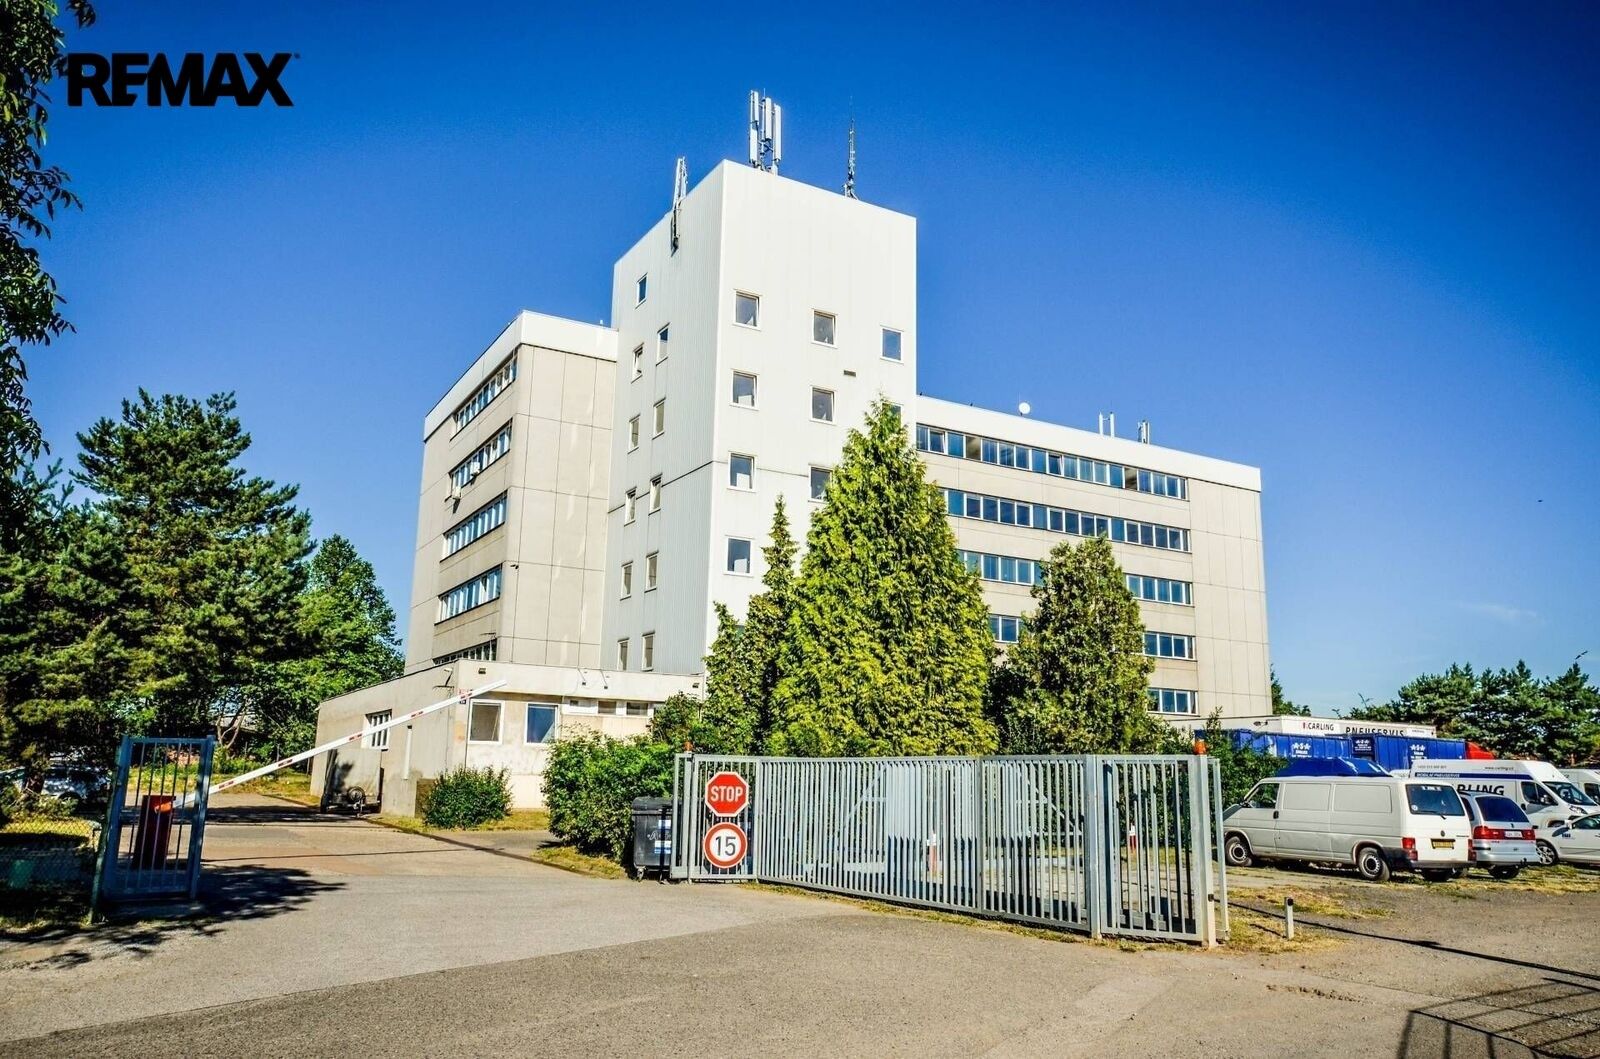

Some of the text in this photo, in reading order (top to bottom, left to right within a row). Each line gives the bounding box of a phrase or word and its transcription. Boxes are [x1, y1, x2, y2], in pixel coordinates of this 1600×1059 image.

[1307, 722, 1335, 731] CARLING
[1345, 726, 1404, 737] PNEUSERVIS
[710, 785, 744, 802] STOP
[1457, 784, 1505, 796] RLING
[715, 835, 737, 857] 15
